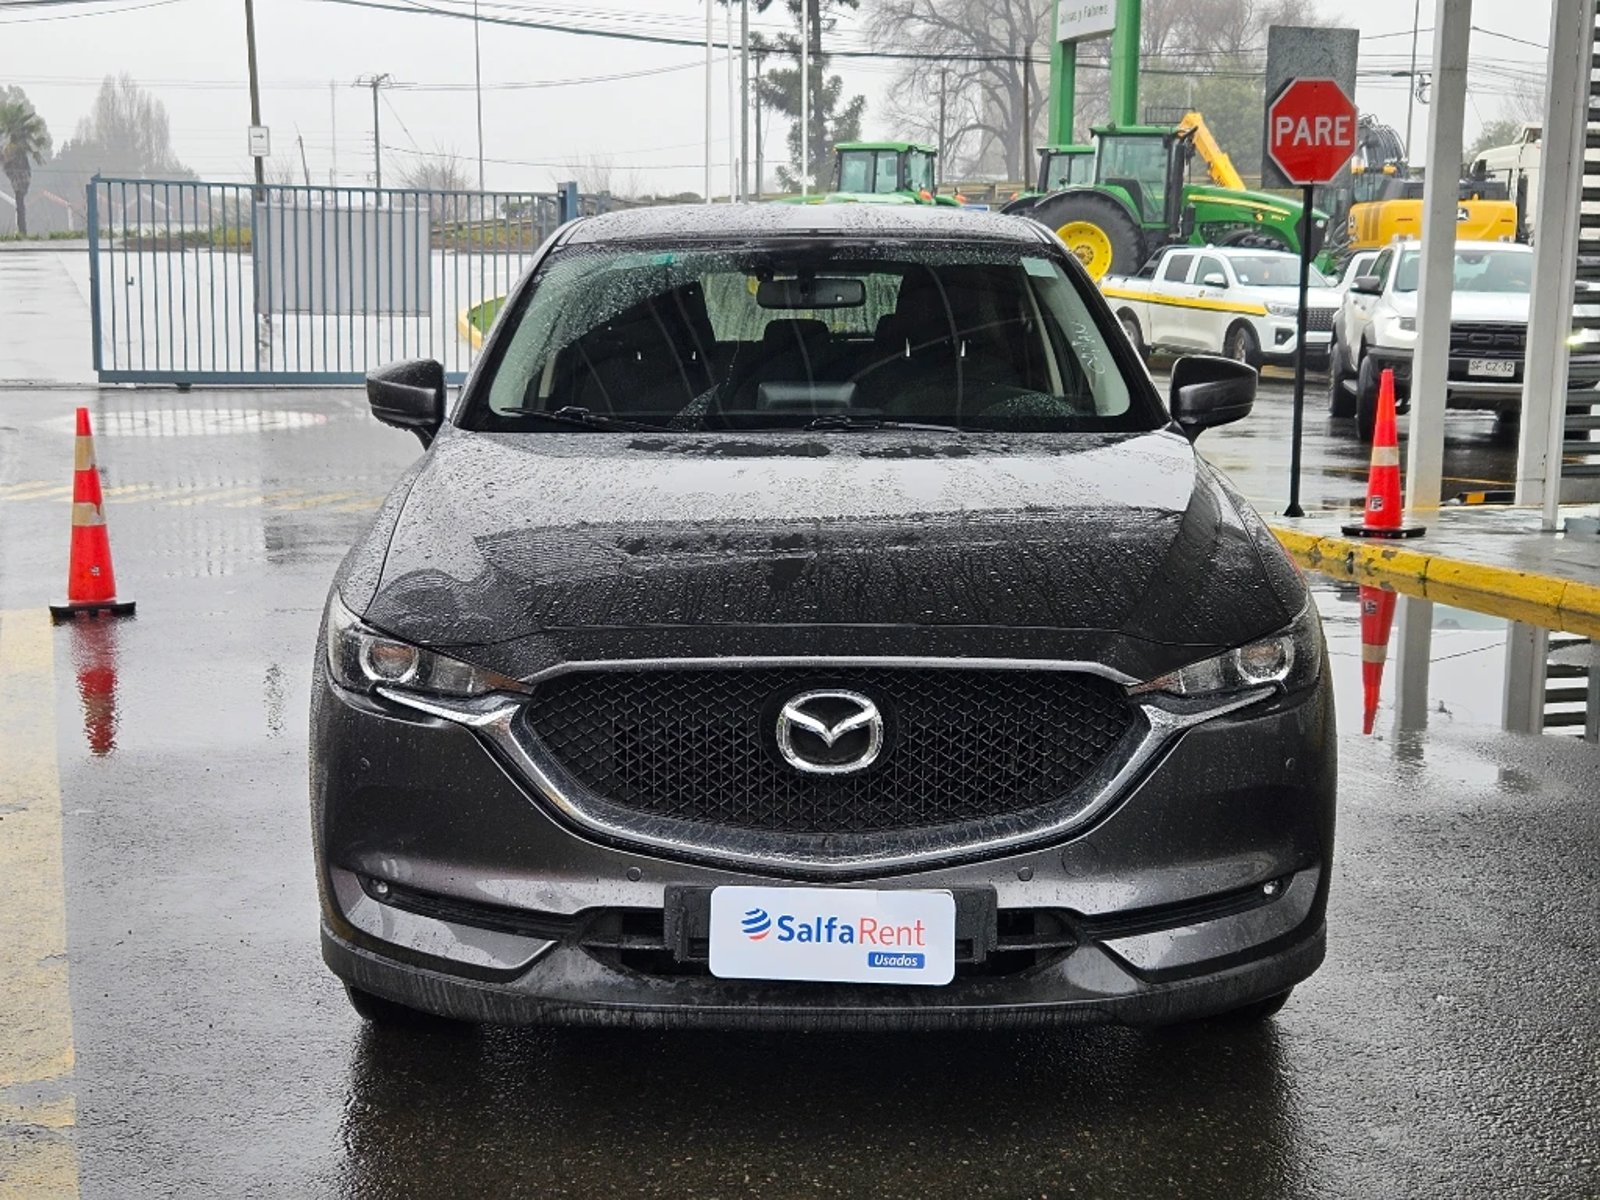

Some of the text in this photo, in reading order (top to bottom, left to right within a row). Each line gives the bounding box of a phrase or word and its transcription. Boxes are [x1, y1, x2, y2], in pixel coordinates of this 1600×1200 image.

[1276, 116, 1351, 146] PARE
[777, 915, 926, 946] SalfaRent
[874, 954, 918, 968] Usados
